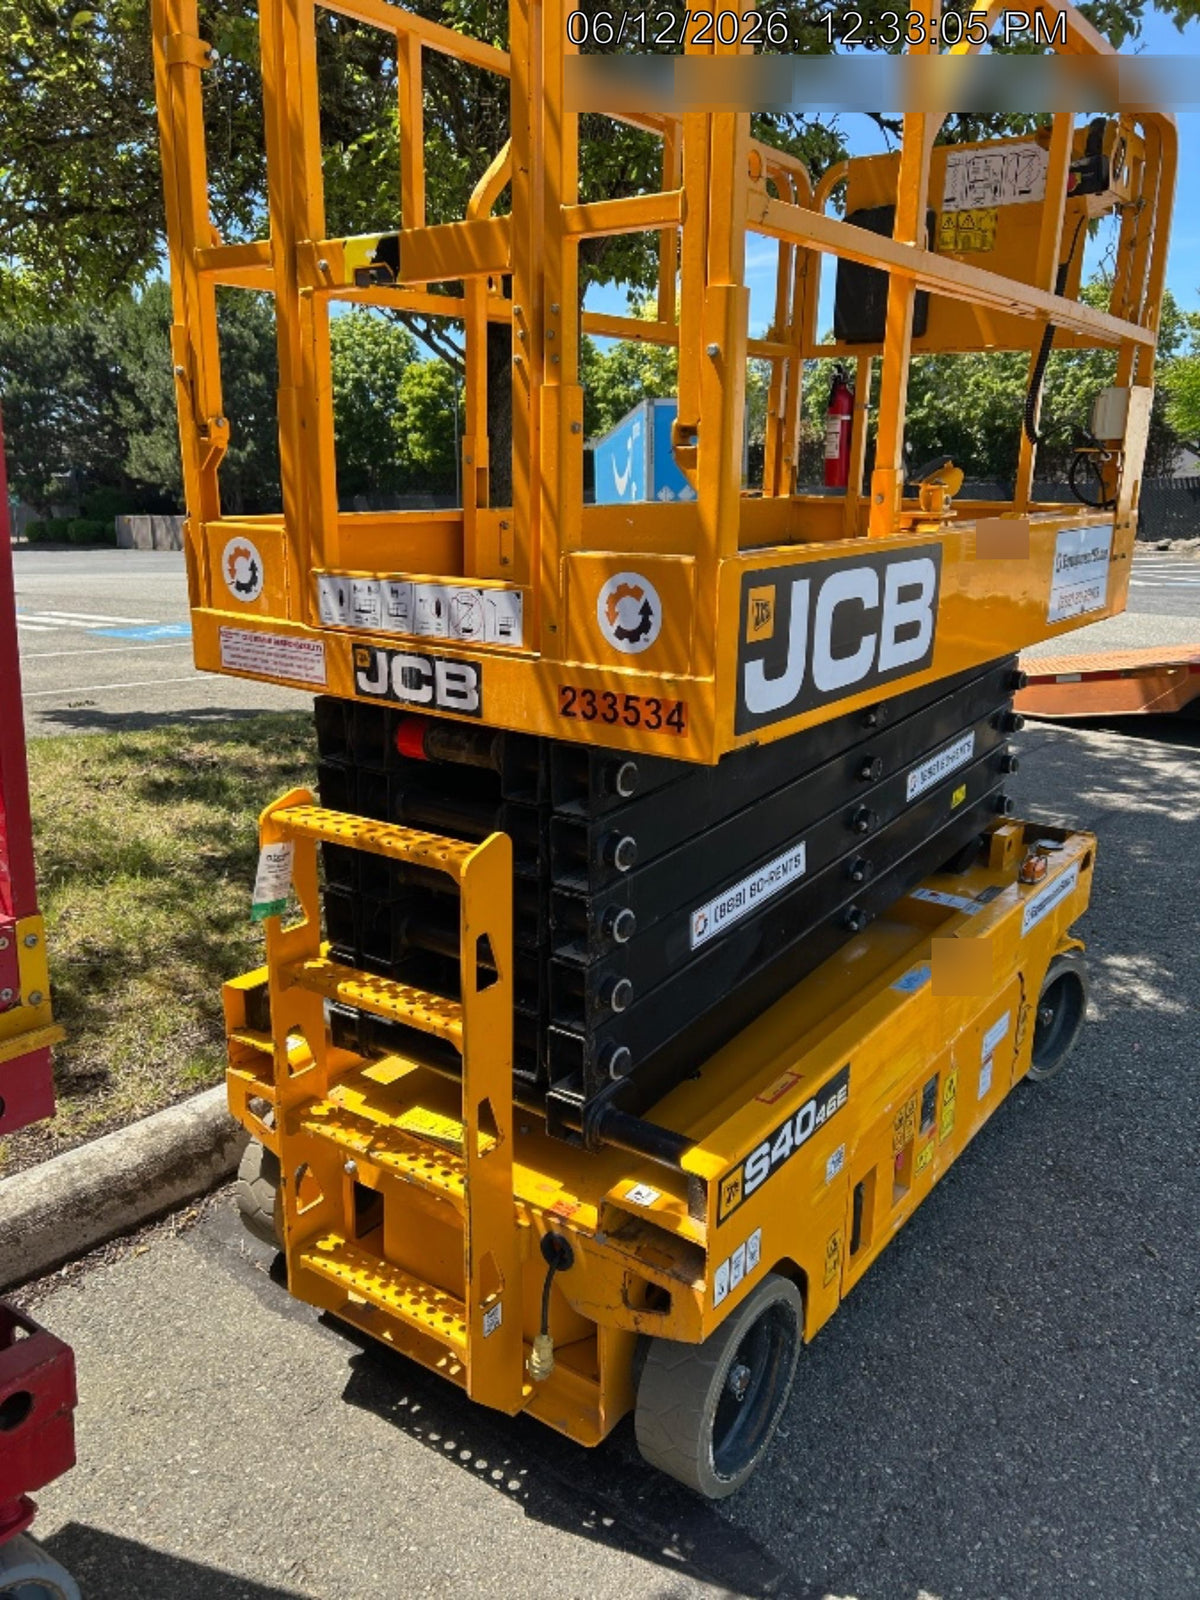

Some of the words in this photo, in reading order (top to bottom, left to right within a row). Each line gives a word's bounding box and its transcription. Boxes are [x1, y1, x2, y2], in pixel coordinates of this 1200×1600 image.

[744, 557, 936, 714] JCB
[356, 650, 480, 711] JCB
[559, 685, 686, 734] 233534
